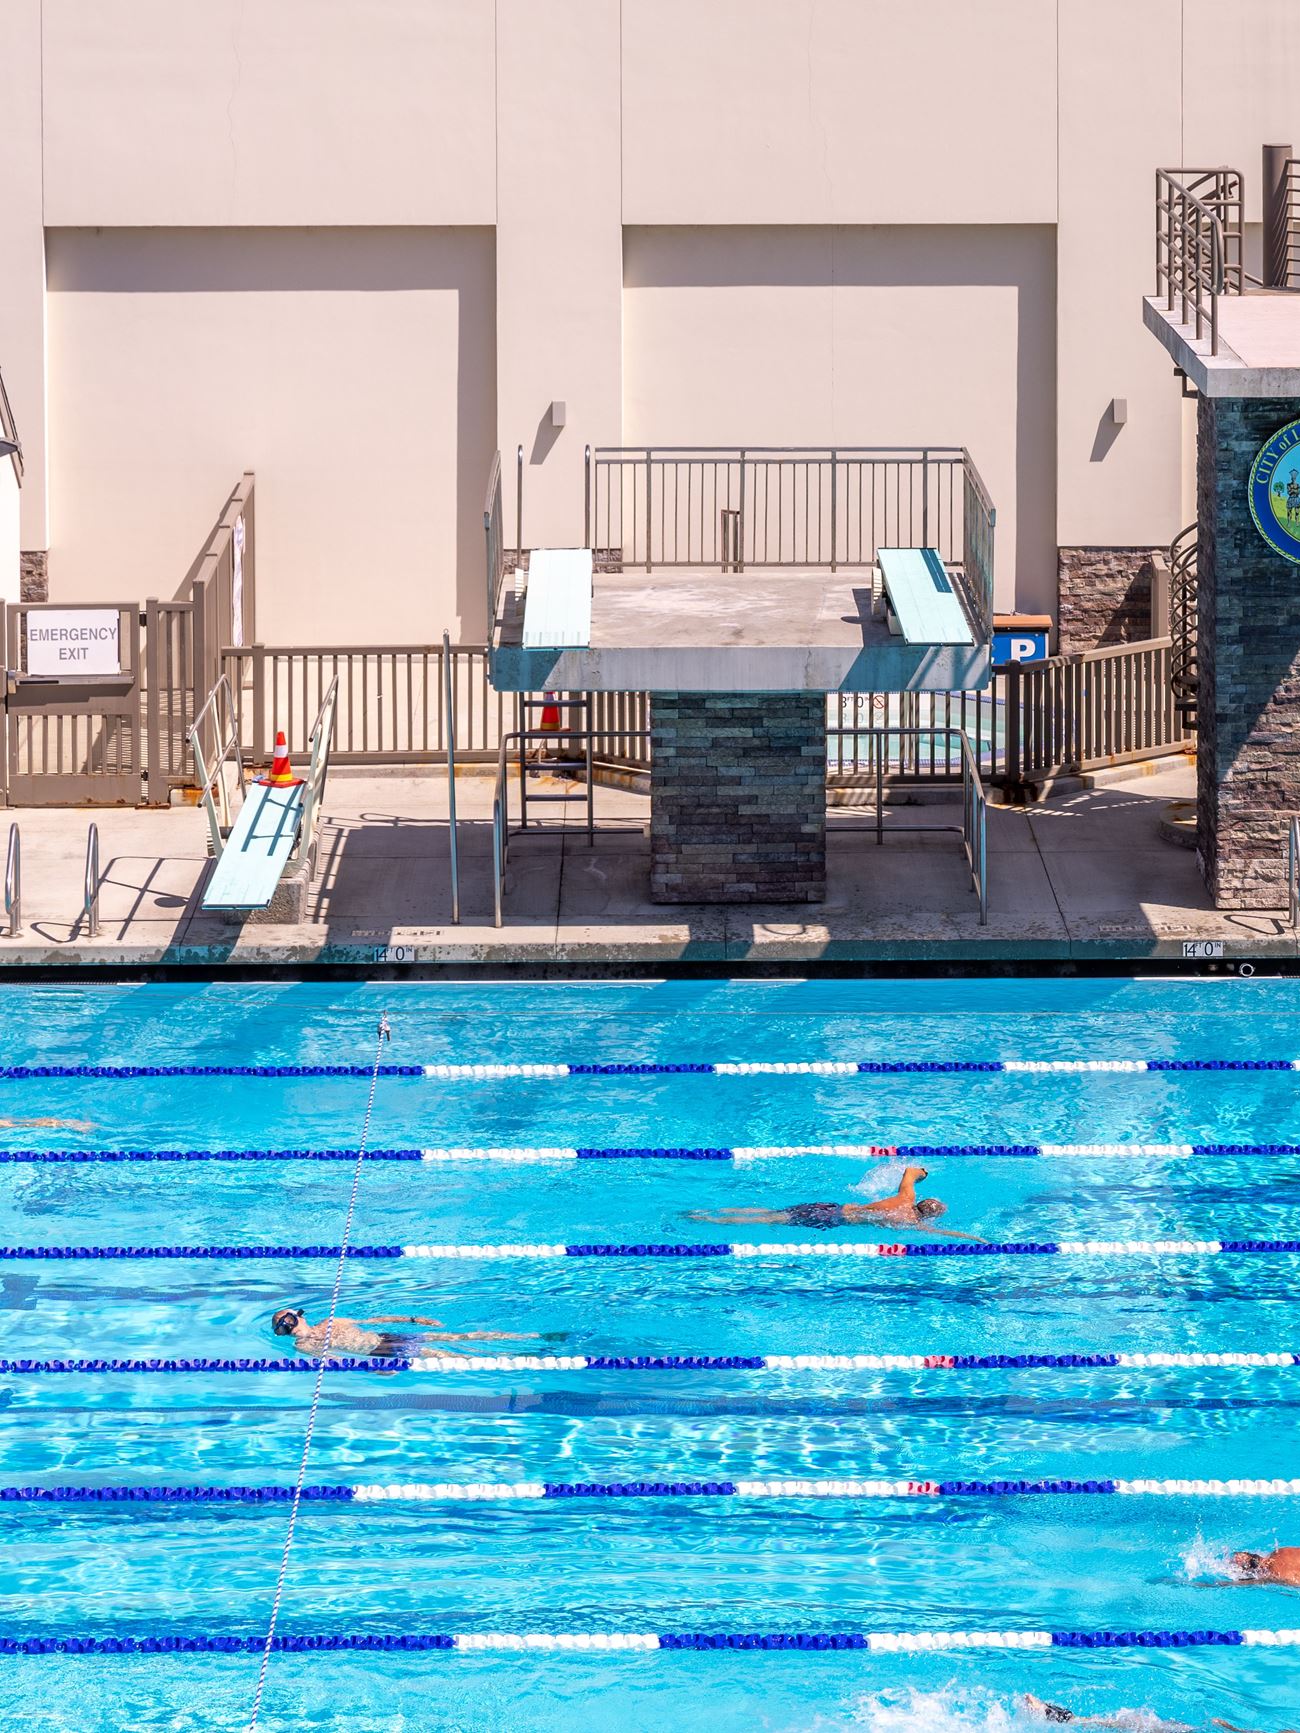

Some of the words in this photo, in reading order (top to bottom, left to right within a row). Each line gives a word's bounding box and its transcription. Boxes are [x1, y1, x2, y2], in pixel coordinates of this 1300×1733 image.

[1256, 448, 1279, 484] CITY
[1279, 435, 1291, 449] of
[30, 628, 117, 641] EMERGENCY
[59, 647, 89, 660] EXIT
